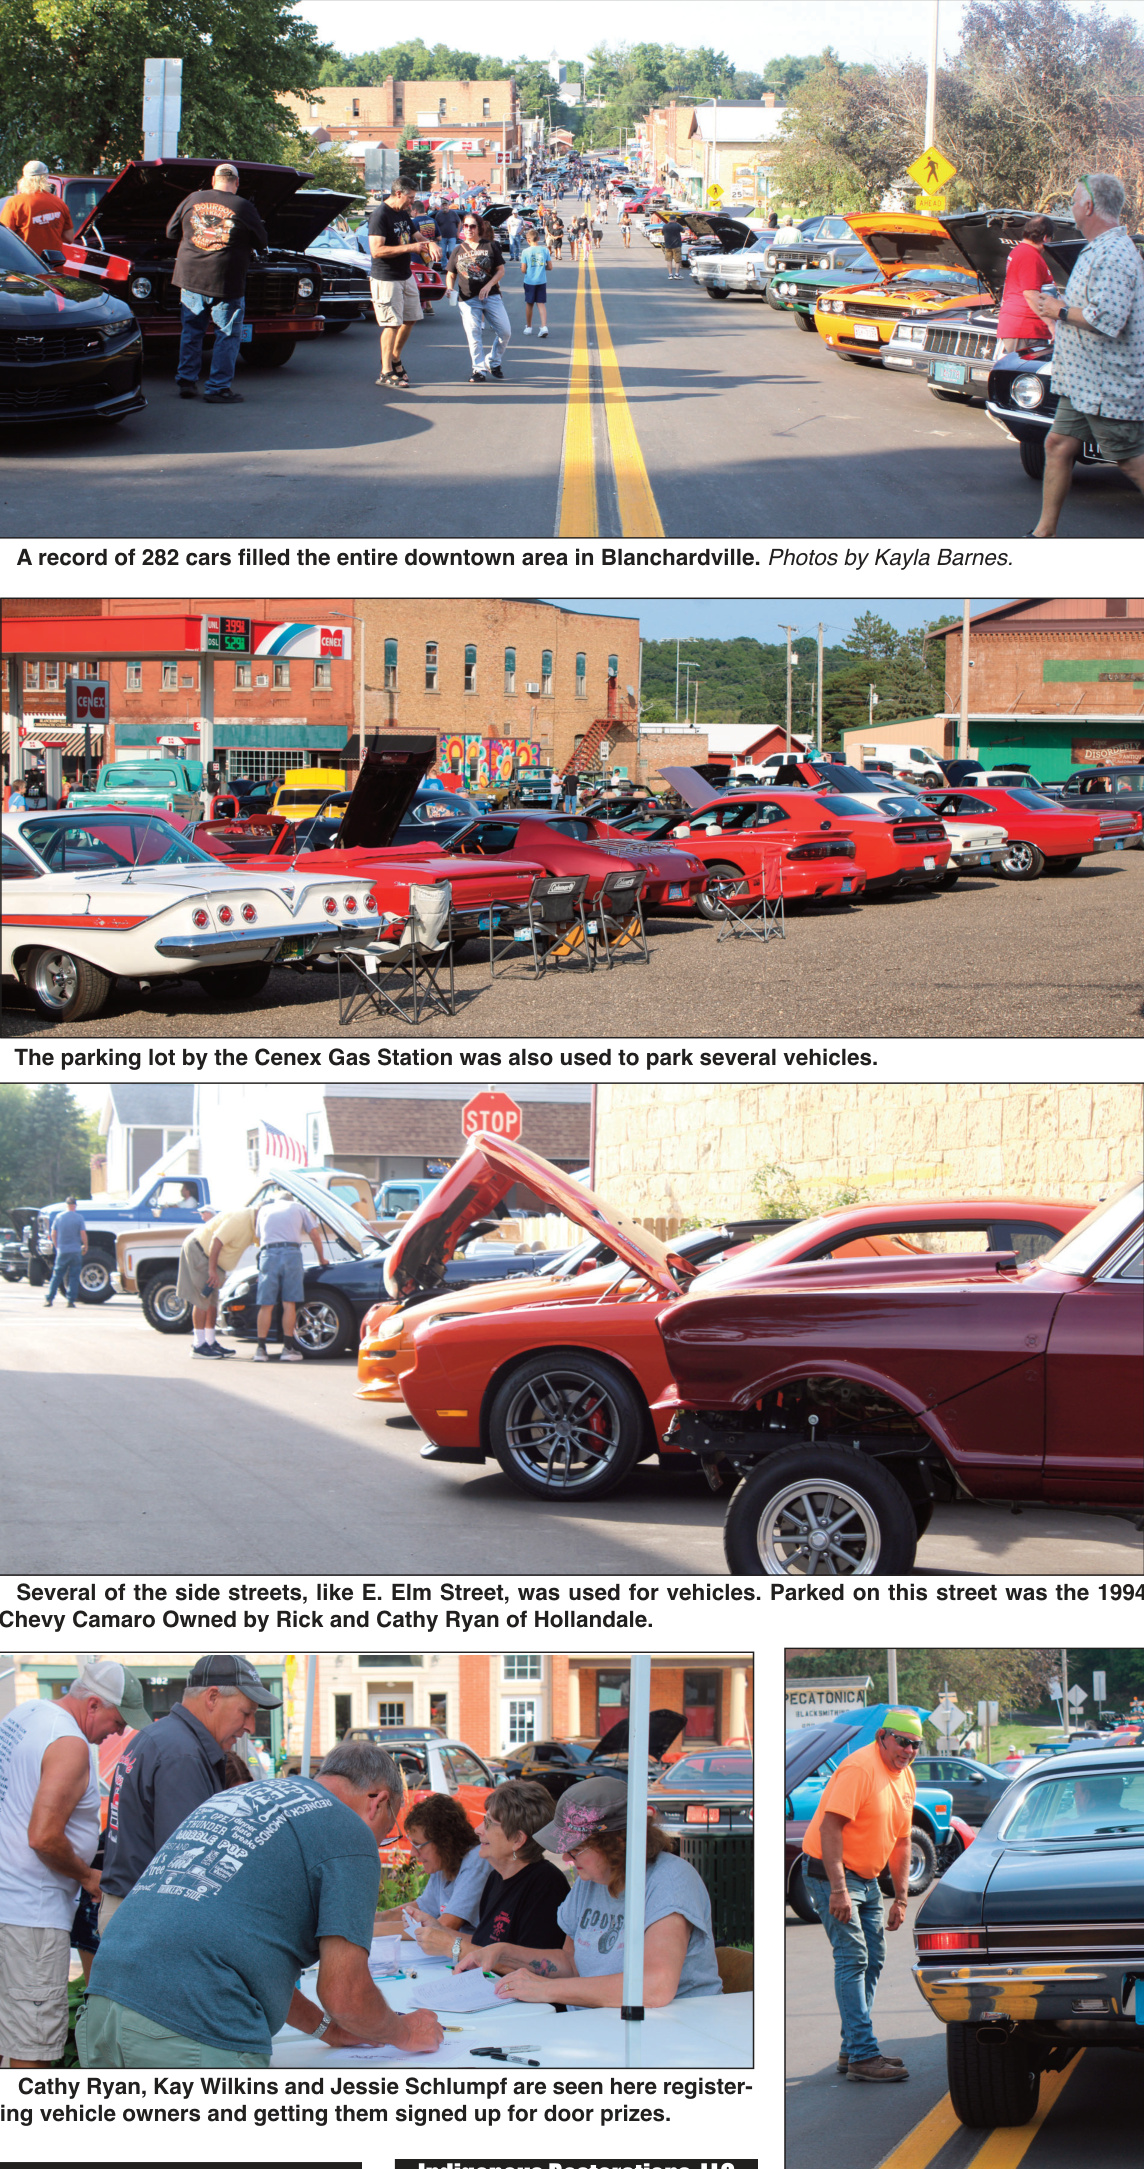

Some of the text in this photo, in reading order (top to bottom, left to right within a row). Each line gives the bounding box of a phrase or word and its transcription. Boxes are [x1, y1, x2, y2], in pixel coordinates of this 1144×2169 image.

[194, 203, 234, 218] BOURBON
[919, 199, 942, 207] AHEAD
[207, 620, 219, 630] UNL
[207, 637, 219, 646] DSL
[321, 637, 342, 648] CENEX
[77, 696, 105, 708] CENEX
[1084, 741, 1140, 759] DISORDERLY
[466, 1110, 518, 1133] STOP
[785, 1689, 865, 1705] PECATONICA
[186, 1820, 228, 1836] THUNDER
[233, 1817, 257, 1833] dinner
[254, 1798, 333, 1846] REDNECK DAMONDS
[231, 1825, 252, 1838] plate
[176, 1829, 219, 1846] WOBBLE
[217, 1839, 249, 1858] POP
[231, 1832, 257, 1850] breaks
[183, 1888, 202, 1902] SIDE
